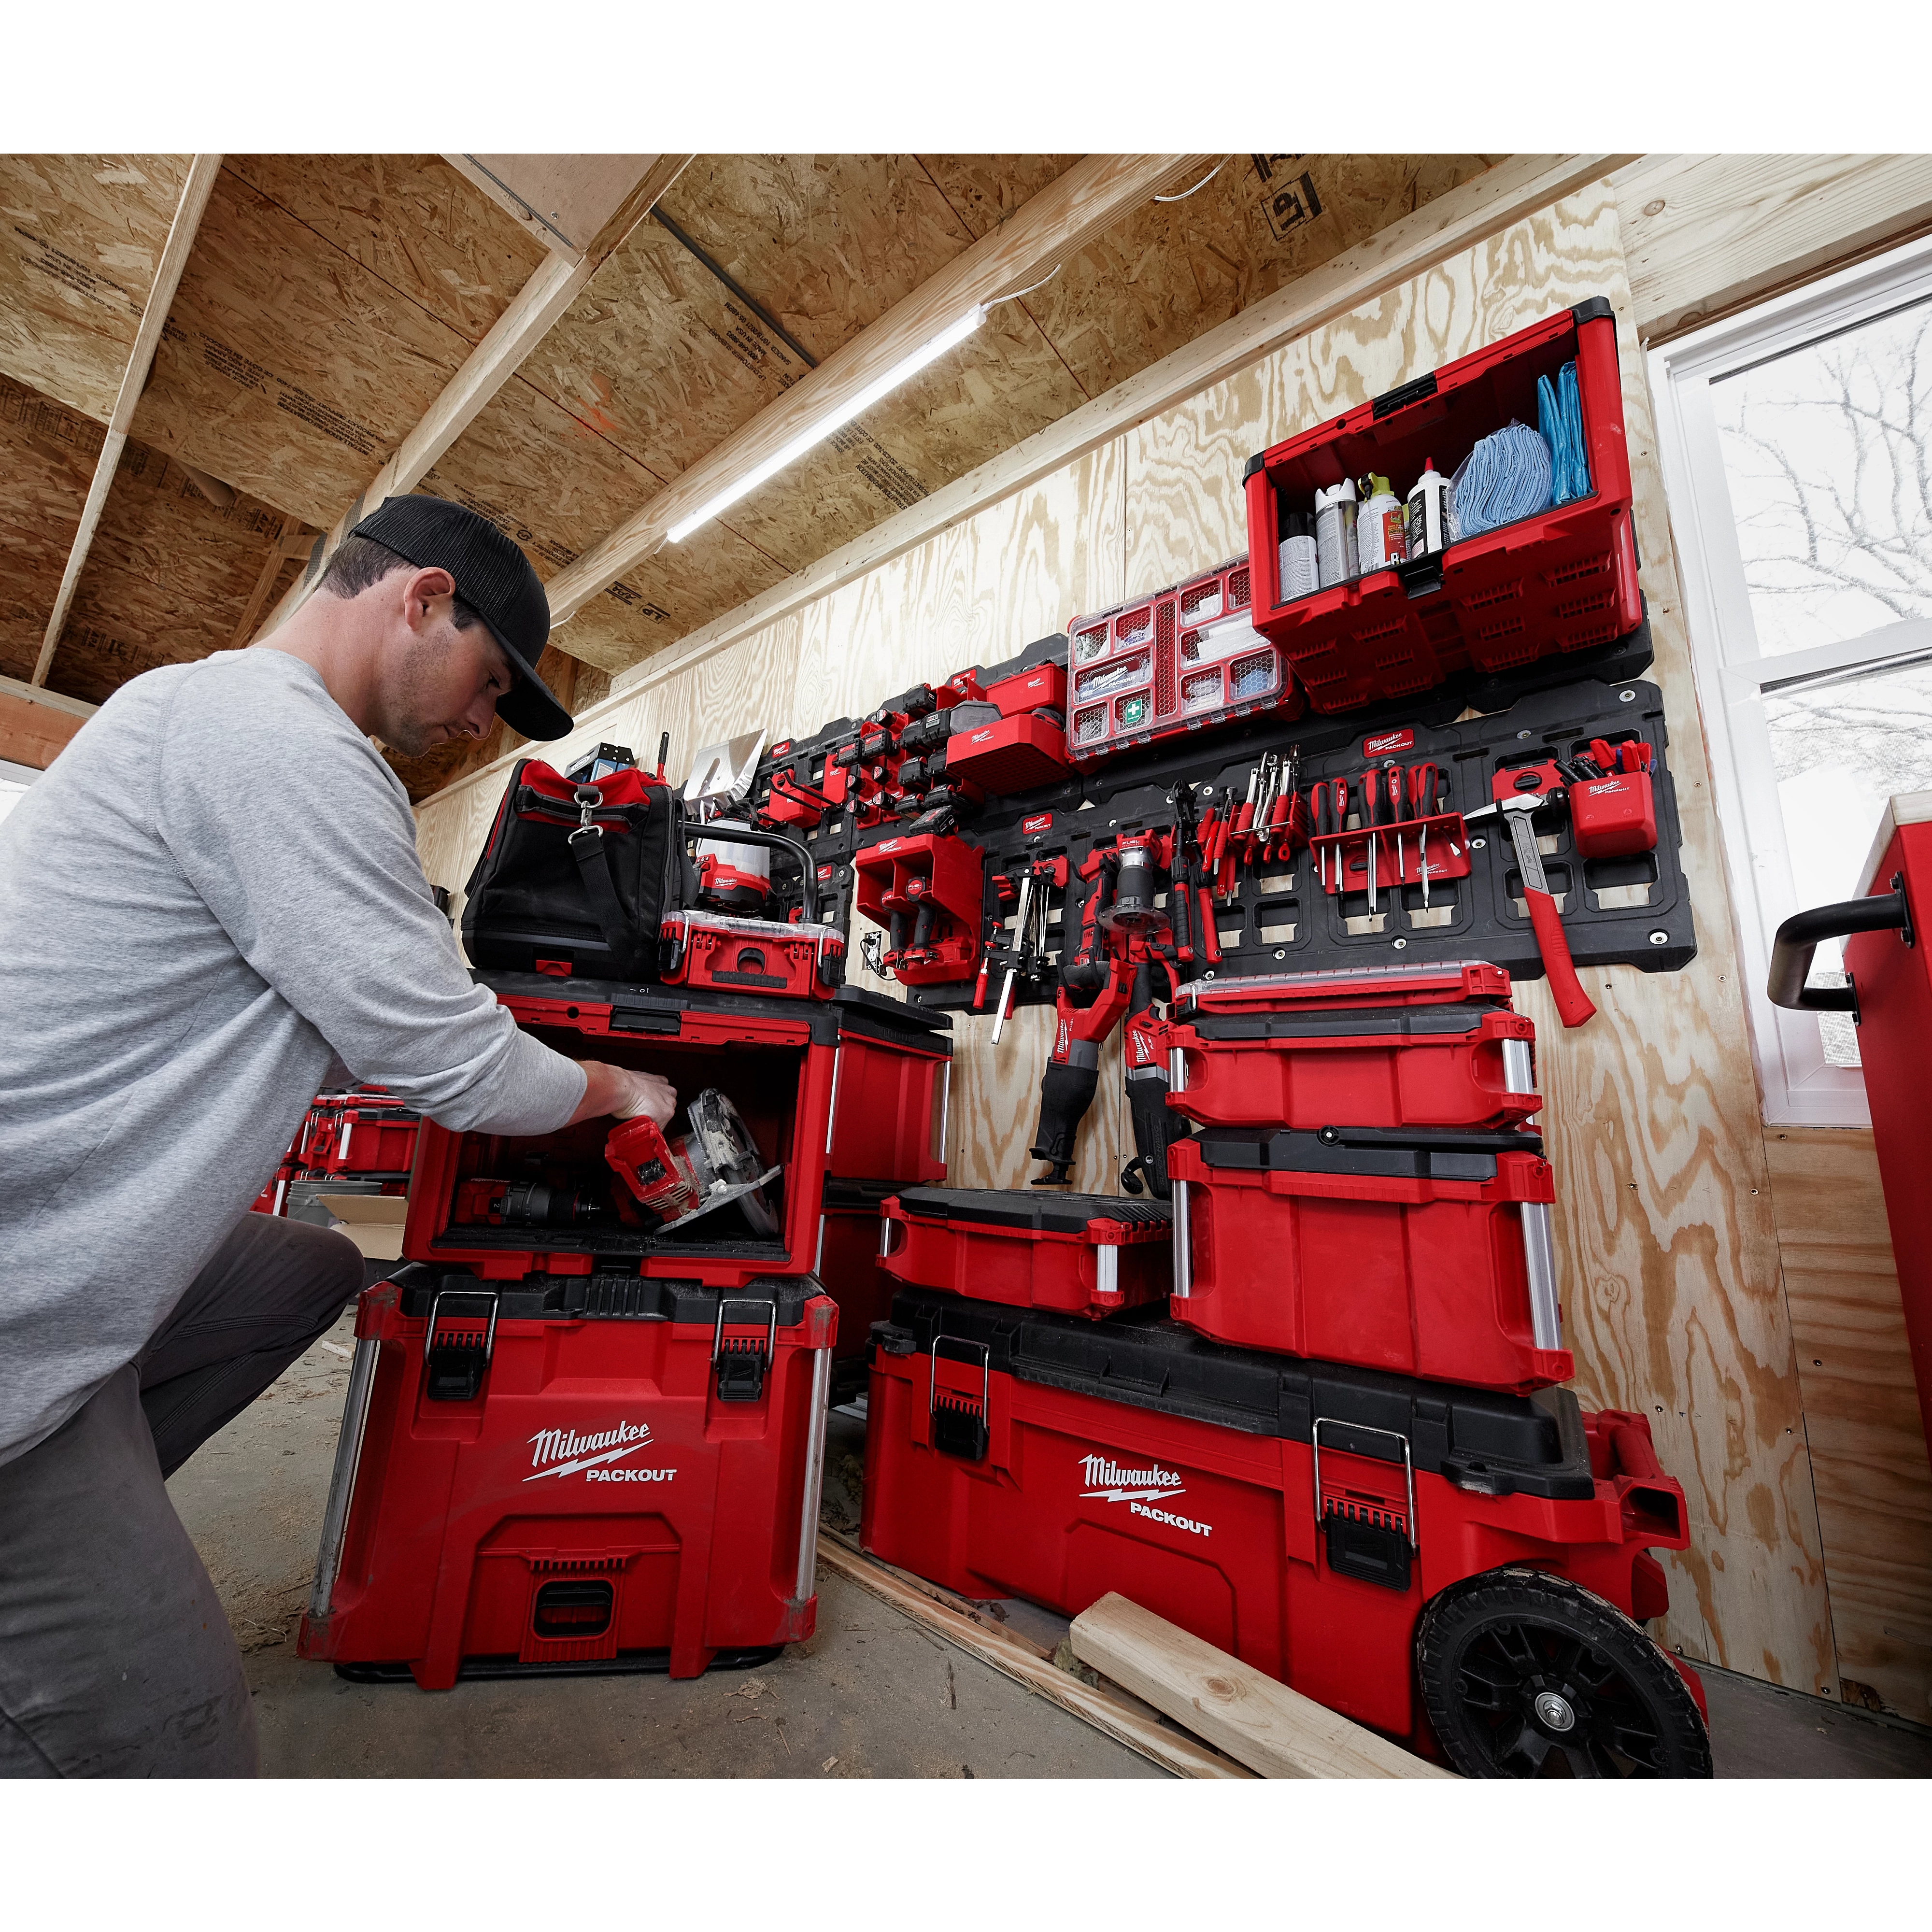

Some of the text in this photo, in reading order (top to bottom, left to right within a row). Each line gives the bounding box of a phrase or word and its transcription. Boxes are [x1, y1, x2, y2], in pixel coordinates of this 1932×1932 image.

[1273, 191, 1305, 231] LP
[20, 254, 60, 280] SUPPORT
[43, 252, 97, 285] MADE IN USA
[60, 278, 107, 307] CUSTOMER
[734, 326, 747, 337] USA
[197, 333, 232, 354] DESSOUS
[751, 341, 767, 355] MADE
[202, 353, 222, 366] ENDS
[203, 342, 265, 379] ESTE LADO ABAJO
[204, 349, 259, 382] THIS SIDE DOWN
[730, 349, 759, 375] CUSTOMER
[204, 360, 253, 389] SPACE PANELS
[232, 370, 248, 381] INCH
[279, 390, 298, 404] WITH
[287, 401, 305, 413] MUST
[296, 402, 337, 426] ACCORDANCE
[293, 395, 366, 438] APA RECOMMENDATIONS
[305, 412, 328, 426] PANELS
[276, 401, 369, 455] INSTALLATION INFORMATION
[347, 419, 375, 437] PRODUCT
[329, 426, 372, 452] PERFORMANCE
[345, 430, 375, 448] INSTALLED
[374, 435, 386, 444] APA
[829, 440, 844, 453] SPACE
[834, 435, 846, 445] INCH
[845, 437, 856, 446] THIS
[852, 433, 864, 444] ESTE
[865, 454, 879, 465] WITH
[866, 463, 878, 474] MUST
[854, 464, 883, 490] INFORMATION
[876, 464, 900, 487] ACCORDANCE
[877, 473, 892, 487] PANELS
[878, 457, 914, 491] RECOMMENDATIONS
[466, 497, 497, 517] CATEGORY
[517, 529, 531, 540] APA
[535, 541, 562, 562] EXPOSURE
[548, 538, 572, 556] MICHIGAN
[611, 584, 636, 603] APA
[641, 605, 662, 622] LP
[1093, 665, 1127, 688] Milwaukee
[1109, 676, 1136, 688] PACKOUT
[971, 730, 990, 741] Milwaukee
[1367, 733, 1402, 750] Milwaukee
[1385, 741, 1412, 750] PACKOUT
[1588, 781, 1619, 793] Milwaukee
[1025, 816, 1045, 829] Milwaukee
[879, 839, 897, 851] Milwaukee
[1132, 1030, 1147, 1063] Milwaukee
[526, 1420, 651, 1468] Milwaukee
[586, 1469, 677, 1482] PACKOUT
[1078, 1453, 1182, 1486] Milwaukee
[1130, 1502, 1212, 1537] PACKOUT
